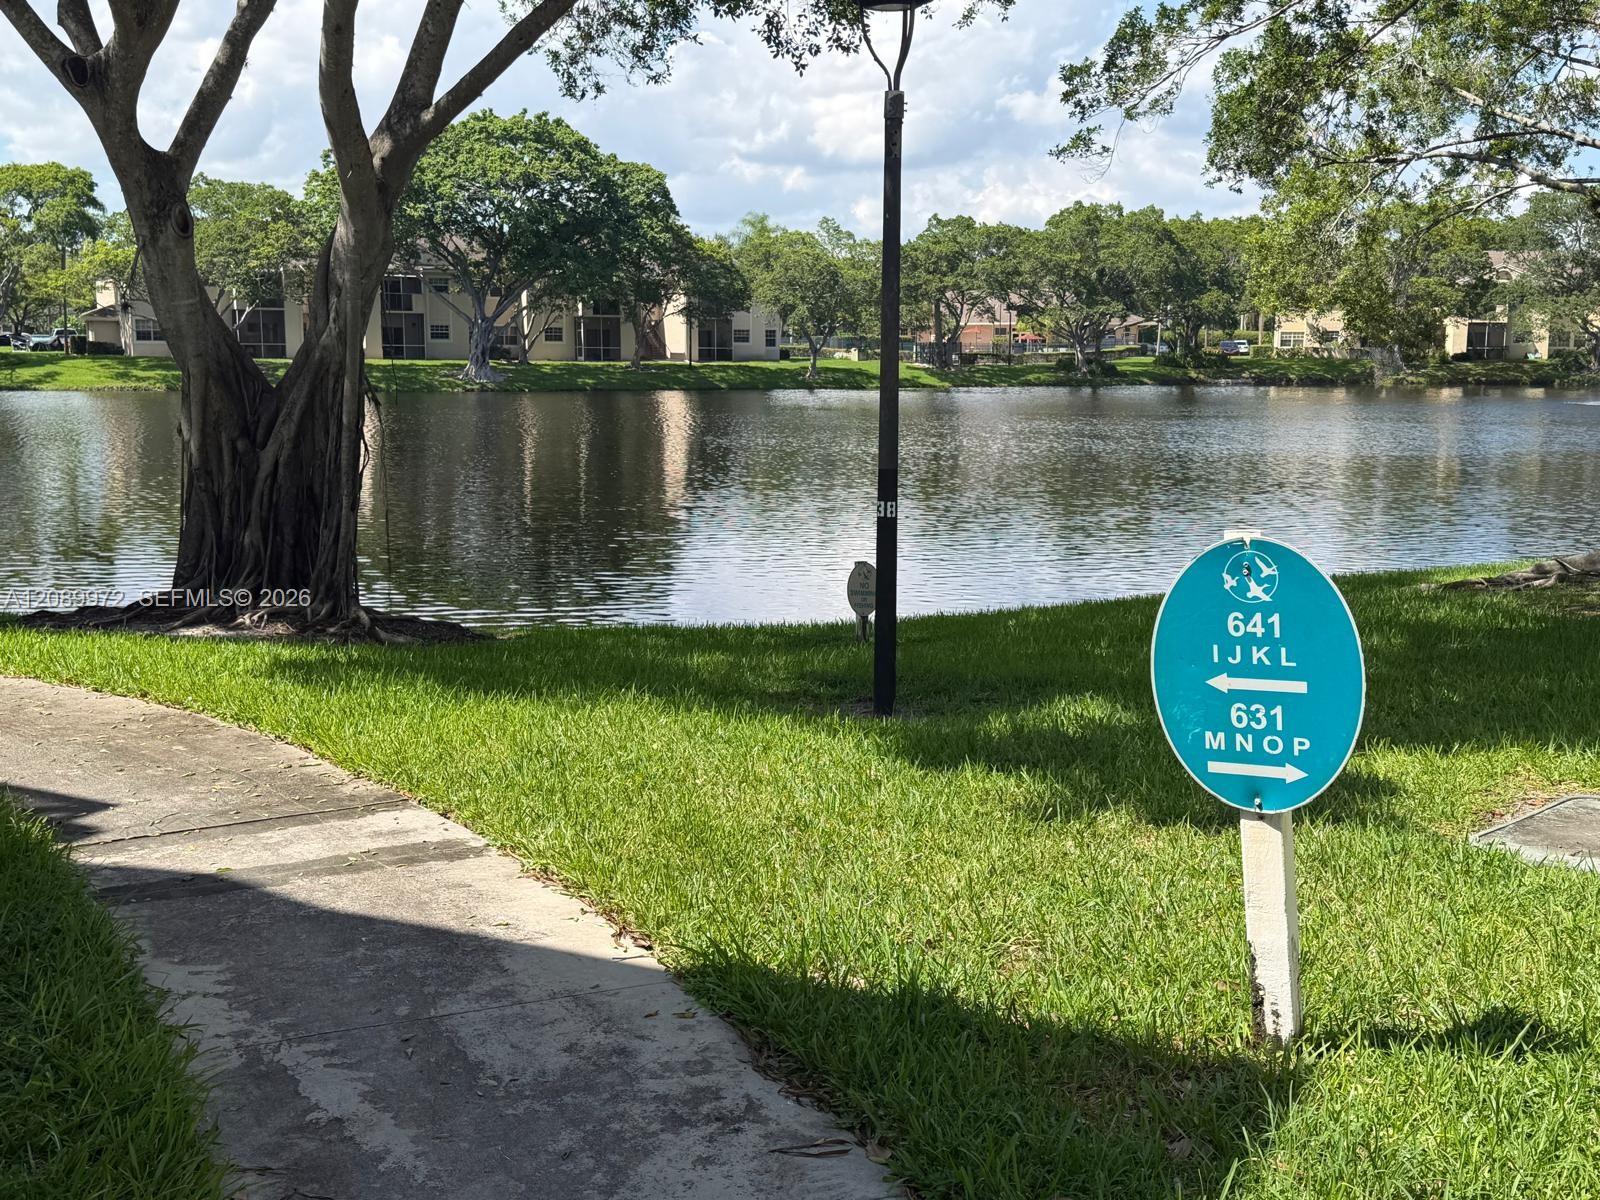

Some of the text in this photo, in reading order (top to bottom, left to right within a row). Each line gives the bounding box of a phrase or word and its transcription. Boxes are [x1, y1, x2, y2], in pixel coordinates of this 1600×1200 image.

[859, 582, 869, 590] NO
[1227, 611, 1281, 639] 641
[1230, 702, 1284, 731] 631
